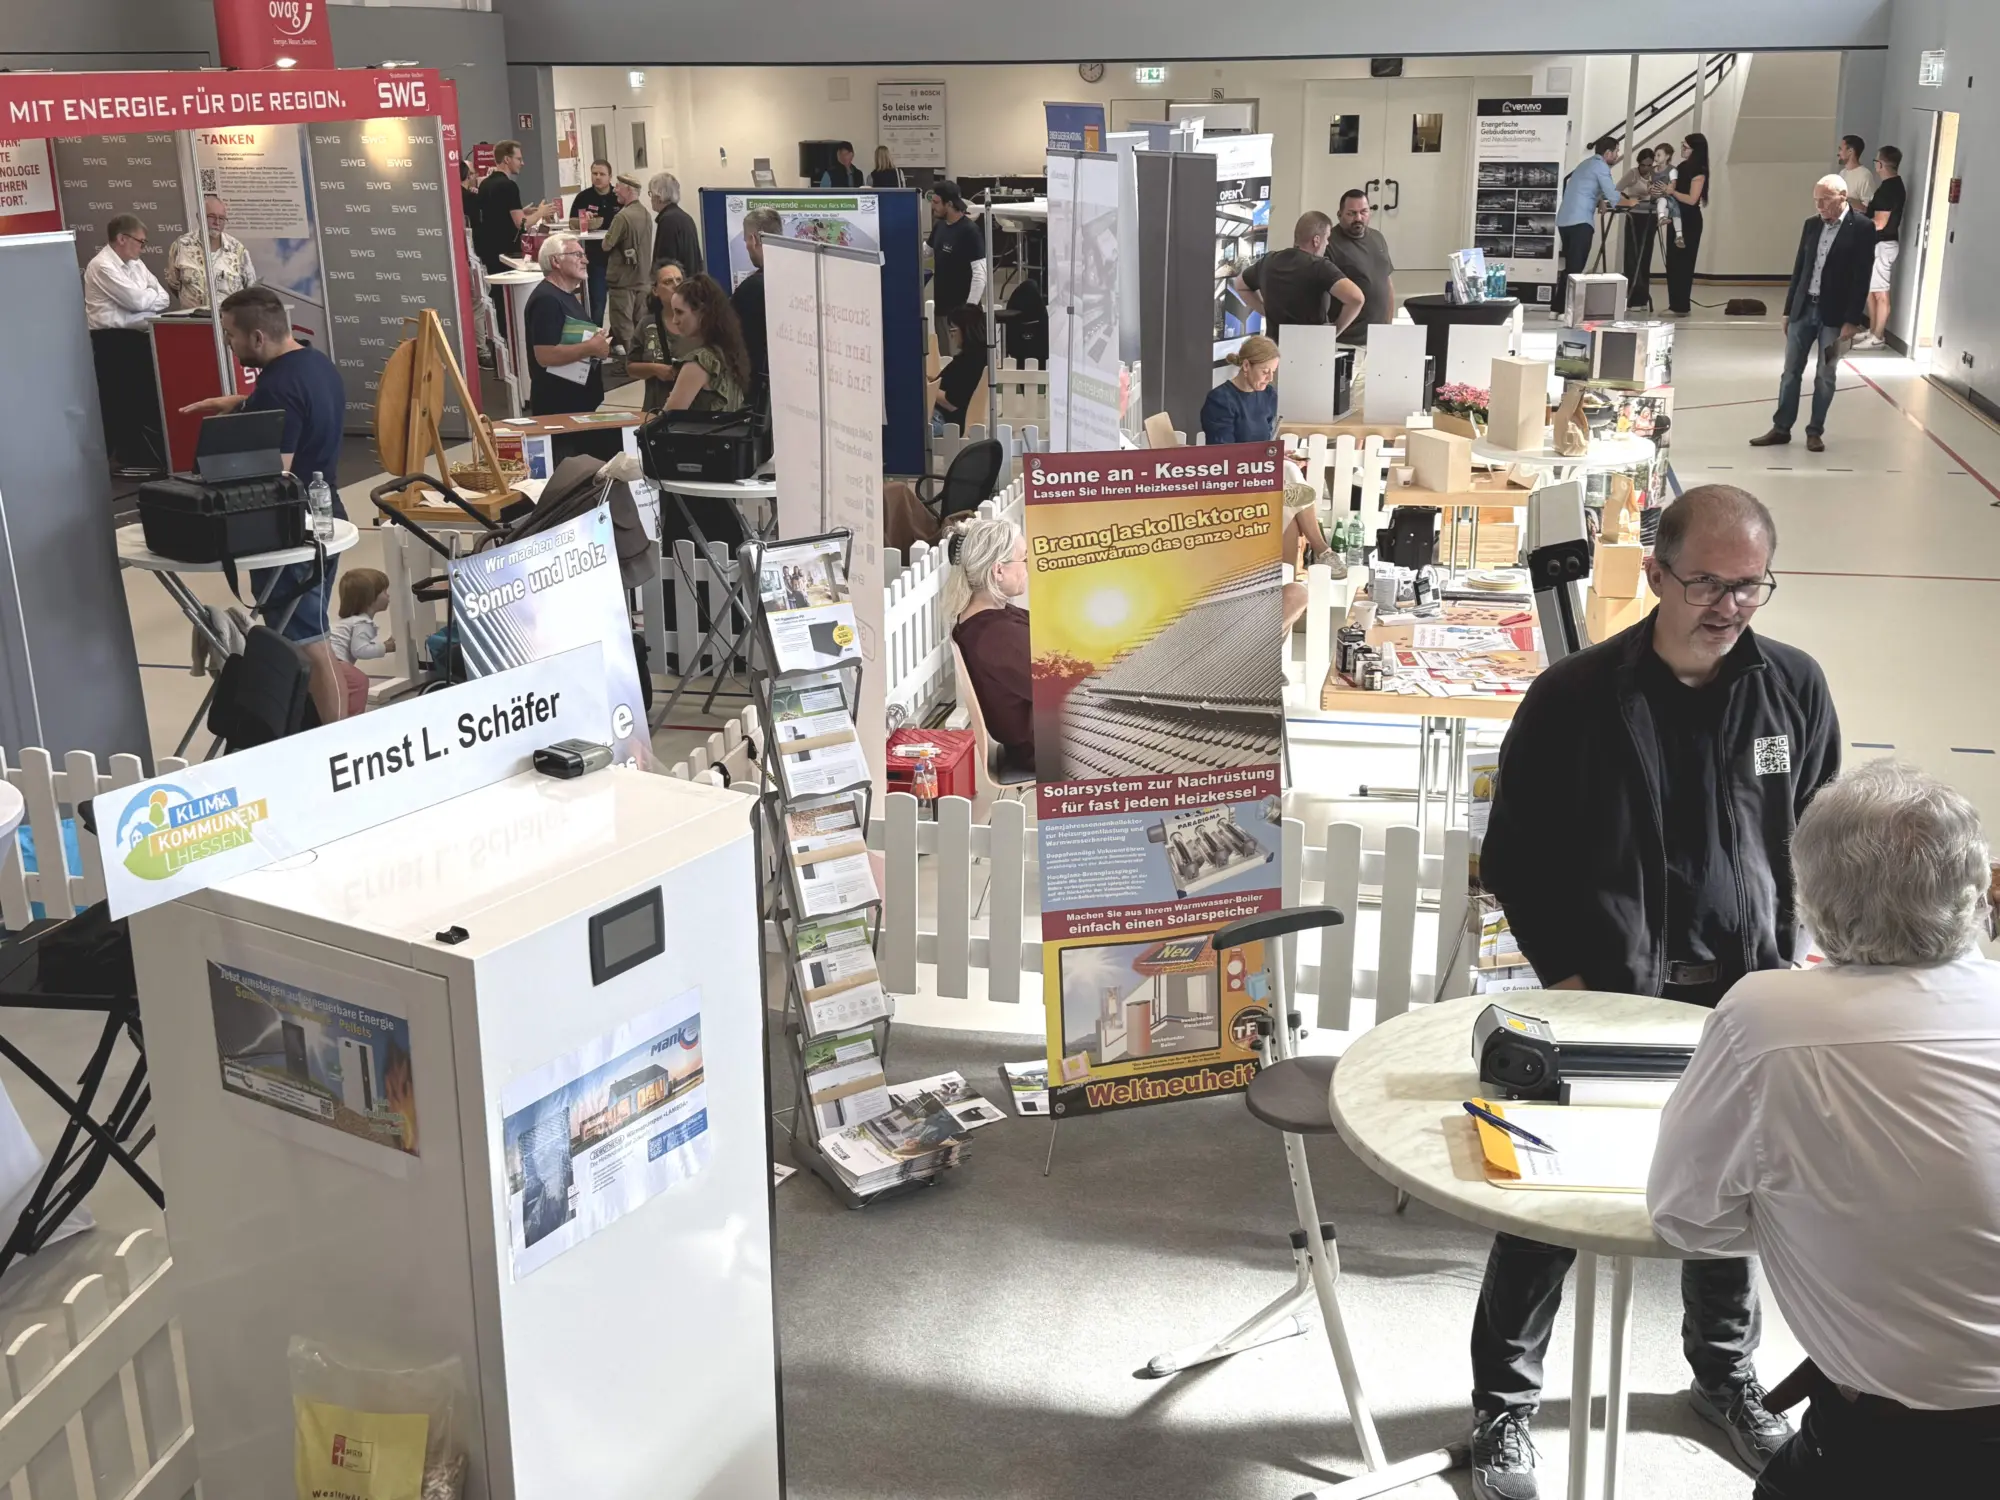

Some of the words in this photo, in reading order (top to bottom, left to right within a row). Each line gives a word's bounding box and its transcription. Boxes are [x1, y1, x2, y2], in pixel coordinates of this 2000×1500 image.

[269, 1, 301, 28] ovag
[378, 81, 426, 108] SWG
[9, 100, 55, 123] MIT
[63, 96, 177, 121] ENERGIE.
[182, 87, 226, 115] FÜR
[231, 92, 264, 113] DIE
[269, 90, 347, 111] REGION.
[882, 103, 893, 111] So
[896, 103, 915, 111] leise
[918, 103, 932, 111] wie
[882, 113, 929, 122] dynamisch:
[58, 136, 82, 144] SWG
[146, 135, 172, 143] SWG
[316, 136, 340, 144] SWG
[408, 136, 434, 144] SWG
[83, 158, 107, 166] SWG
[127, 158, 152, 166] SWG
[340, 159, 366, 167] SWG
[386, 159, 412, 167] SWG
[64, 180, 88, 188] SWG
[108, 180, 132, 188] SWG
[153, 180, 177, 188] SWG
[320, 182, 345, 190] SWG
[366, 182, 391, 190] SWG
[0, 195, 27, 207] FORT.
[88, 202, 113, 210] SWG
[133, 202, 157, 210] SWG
[346, 204, 370, 212] SWG
[392, 205, 416, 213] SWG
[70, 224, 94, 232] SWG
[158, 224, 182, 232] SWG
[417, 228, 442, 236] SWG
[350, 250, 375, 258] SWG
[396, 250, 422, 258] SWG
[376, 272, 400, 280] SWG
[422, 274, 447, 282] SWG
[355, 294, 380, 302] SWG
[401, 295, 426, 303] SWG
[334, 316, 360, 324] SWG
[380, 316, 404, 324] SWG
[360, 338, 384, 346] SWG
[340, 359, 364, 367] SWG
[1032, 468, 1100, 485] Sonne
[1108, 468, 1133, 482] an
[1155, 460, 1229, 479] Kessel
[1236, 460, 1276, 475] aus
[1034, 488, 1075, 499] Lassen
[1079, 486, 1097, 496] Sie
[1101, 485, 1131, 495] Ihren
[1136, 481, 1199, 493] Heizkessel
[1202, 479, 1239, 490] länger
[1243, 477, 1274, 487] leben
[1033, 502, 1269, 555] Brennglaskollektoren
[485, 554, 505, 574] Wir
[508, 538, 553, 567] machen
[556, 527, 575, 547] aus
[1037, 542, 1149, 572] Sonnenwärme
[1152, 537, 1182, 553] das
[1184, 529, 1232, 550] ganze
[1235, 521, 1271, 539] Jahr
[464, 577, 525, 620] Sonne
[528, 555, 564, 593] und
[566, 542, 606, 579] Holz
[330, 734, 416, 793] Ernst
[422, 727, 449, 763] L.
[457, 692, 561, 748] Schäfer
[1044, 781, 1143, 798] Solarsystem
[1148, 777, 1173, 790] zur
[1177, 768, 1275, 789] Nachrüstung
[1061, 801, 1084, 814] für
[1089, 799, 1120, 811] fast
[1124, 793, 1169, 812] jeden
[1174, 786, 1257, 806] Heizkessel
[176, 793, 231, 824] KLIMA
[1178, 813, 1220, 830] PARADIGMA
[158, 804, 260, 851] KOMMUNEN
[177, 831, 245, 866] HESSEN
[1066, 911, 1104, 922] Machen
[1107, 909, 1122, 918] Sie
[1125, 908, 1142, 916] aus
[1145, 905, 1172, 915] Ihrem
[1174, 894, 1263, 911] Warmwasser-Boiler
[1069, 920, 1121, 934] einfach
[1125, 918, 1163, 930] einen
[1167, 905, 1260, 925] Solarspeicher
[1157, 946, 1195, 959] Neu
[220, 969, 241, 981] Jetzt
[242, 975, 286, 997] umsteigen
[359, 1010, 394, 1031] Energie
[1086, 1064, 1256, 1107] Weltneuheit
